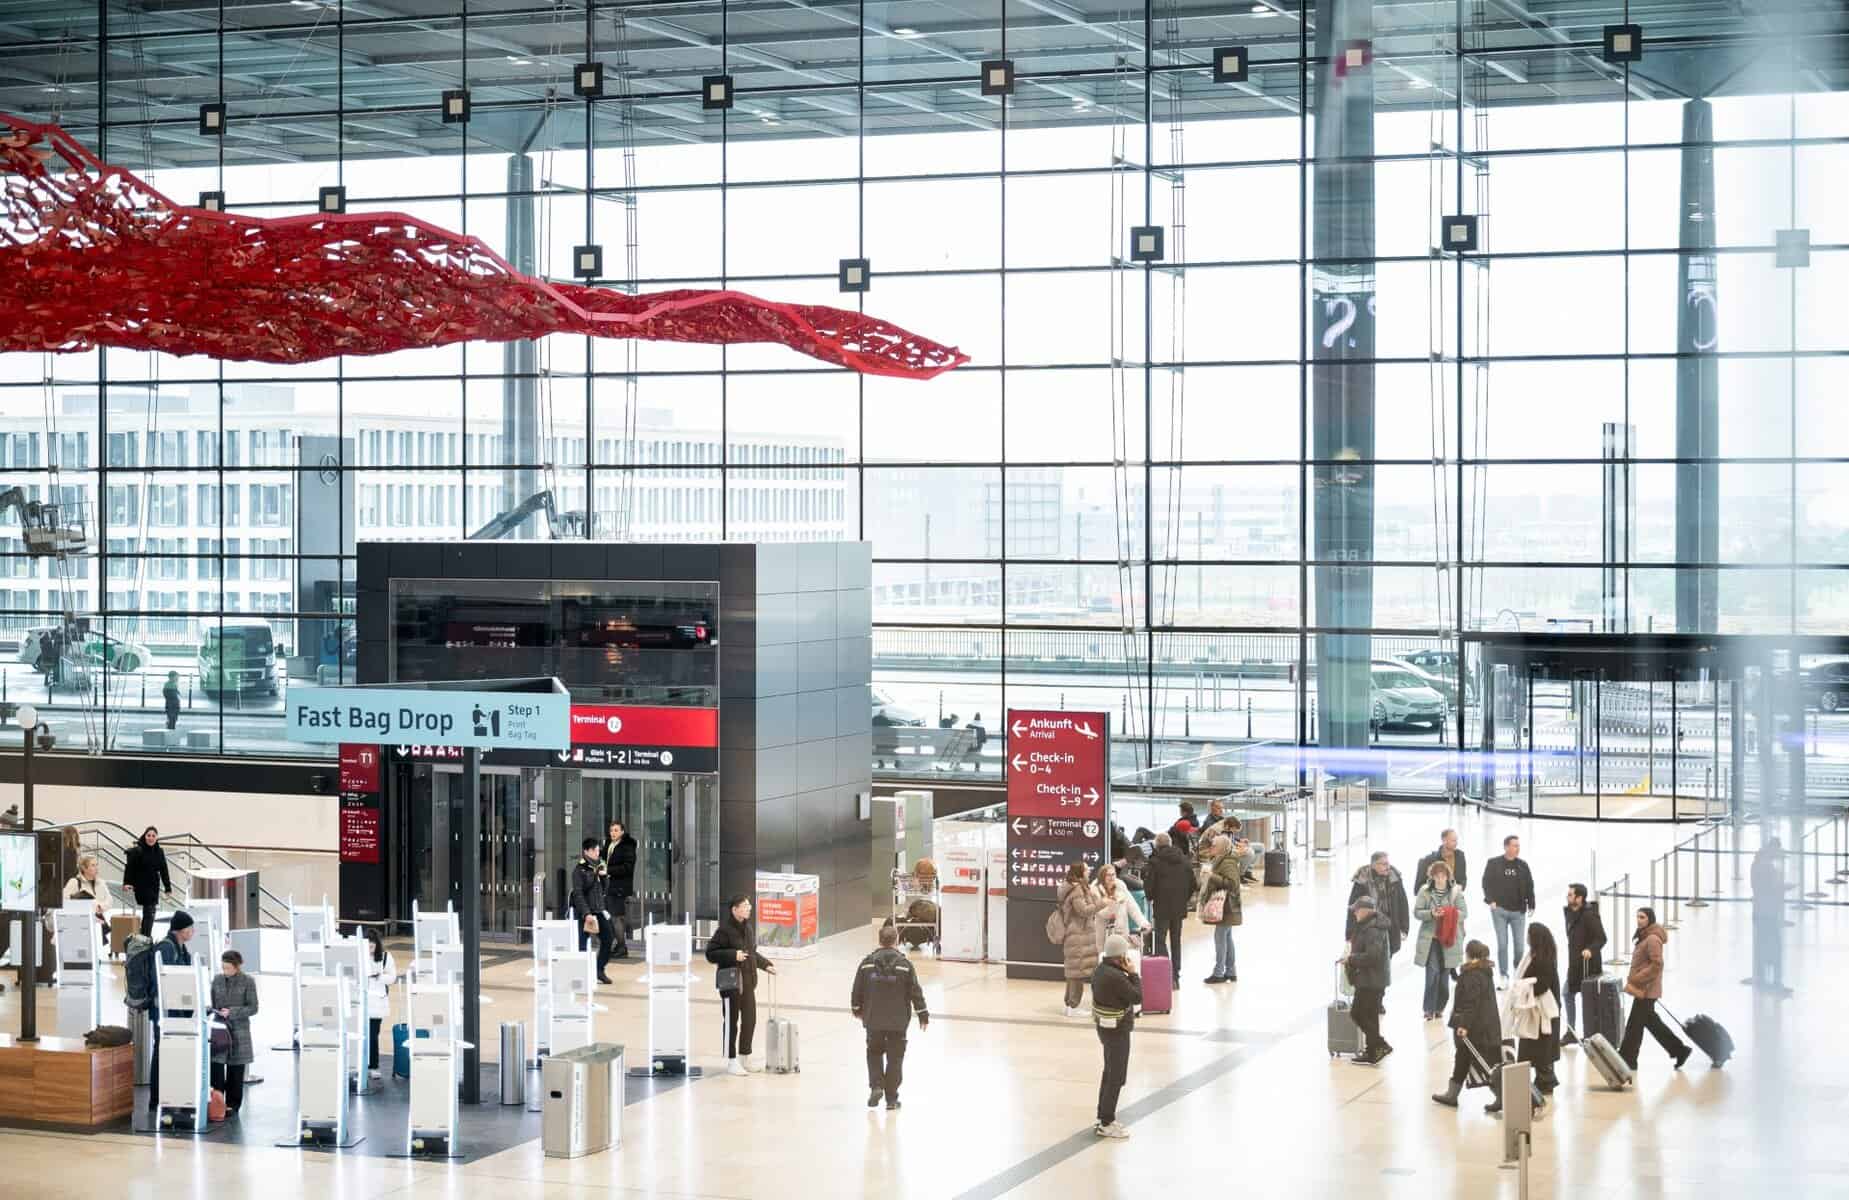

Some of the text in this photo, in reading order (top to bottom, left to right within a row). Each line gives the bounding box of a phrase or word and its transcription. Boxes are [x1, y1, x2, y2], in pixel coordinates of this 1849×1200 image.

[508, 704, 540, 718] Step 1
[298, 706, 453, 736] Fast Bag Drop
[573, 715, 605, 724] Terminal
[1030, 718, 1073, 729] Ankunft
[508, 730, 537, 740] Bag Tag
[1030, 730, 1056, 739] Arrival
[360, 752, 372, 764] T1
[1030, 752, 1075, 763] Check-in
[1036, 783, 1081, 795] Check-in
[1048, 818, 1082, 828] Terminal
